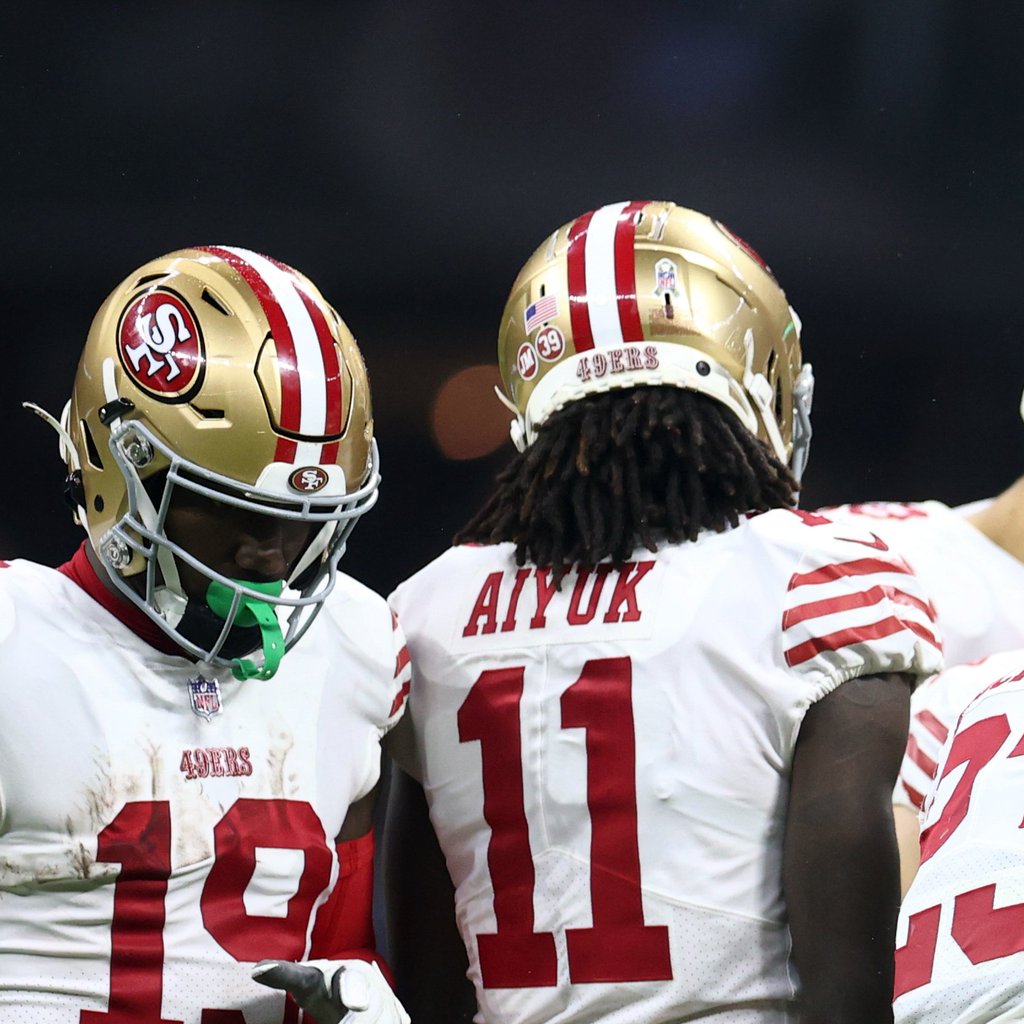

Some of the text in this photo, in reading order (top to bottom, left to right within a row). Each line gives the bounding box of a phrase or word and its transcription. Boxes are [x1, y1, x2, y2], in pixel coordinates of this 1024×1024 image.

[538, 329, 562, 357] 39
[518, 348, 536, 375] JM
[576, 345, 661, 382] 49ERS
[301, 470, 323, 490] SF
[462, 560, 656, 637] AIYUK
[180, 746, 254, 781] 49ERS
[457, 655, 674, 990] 11
